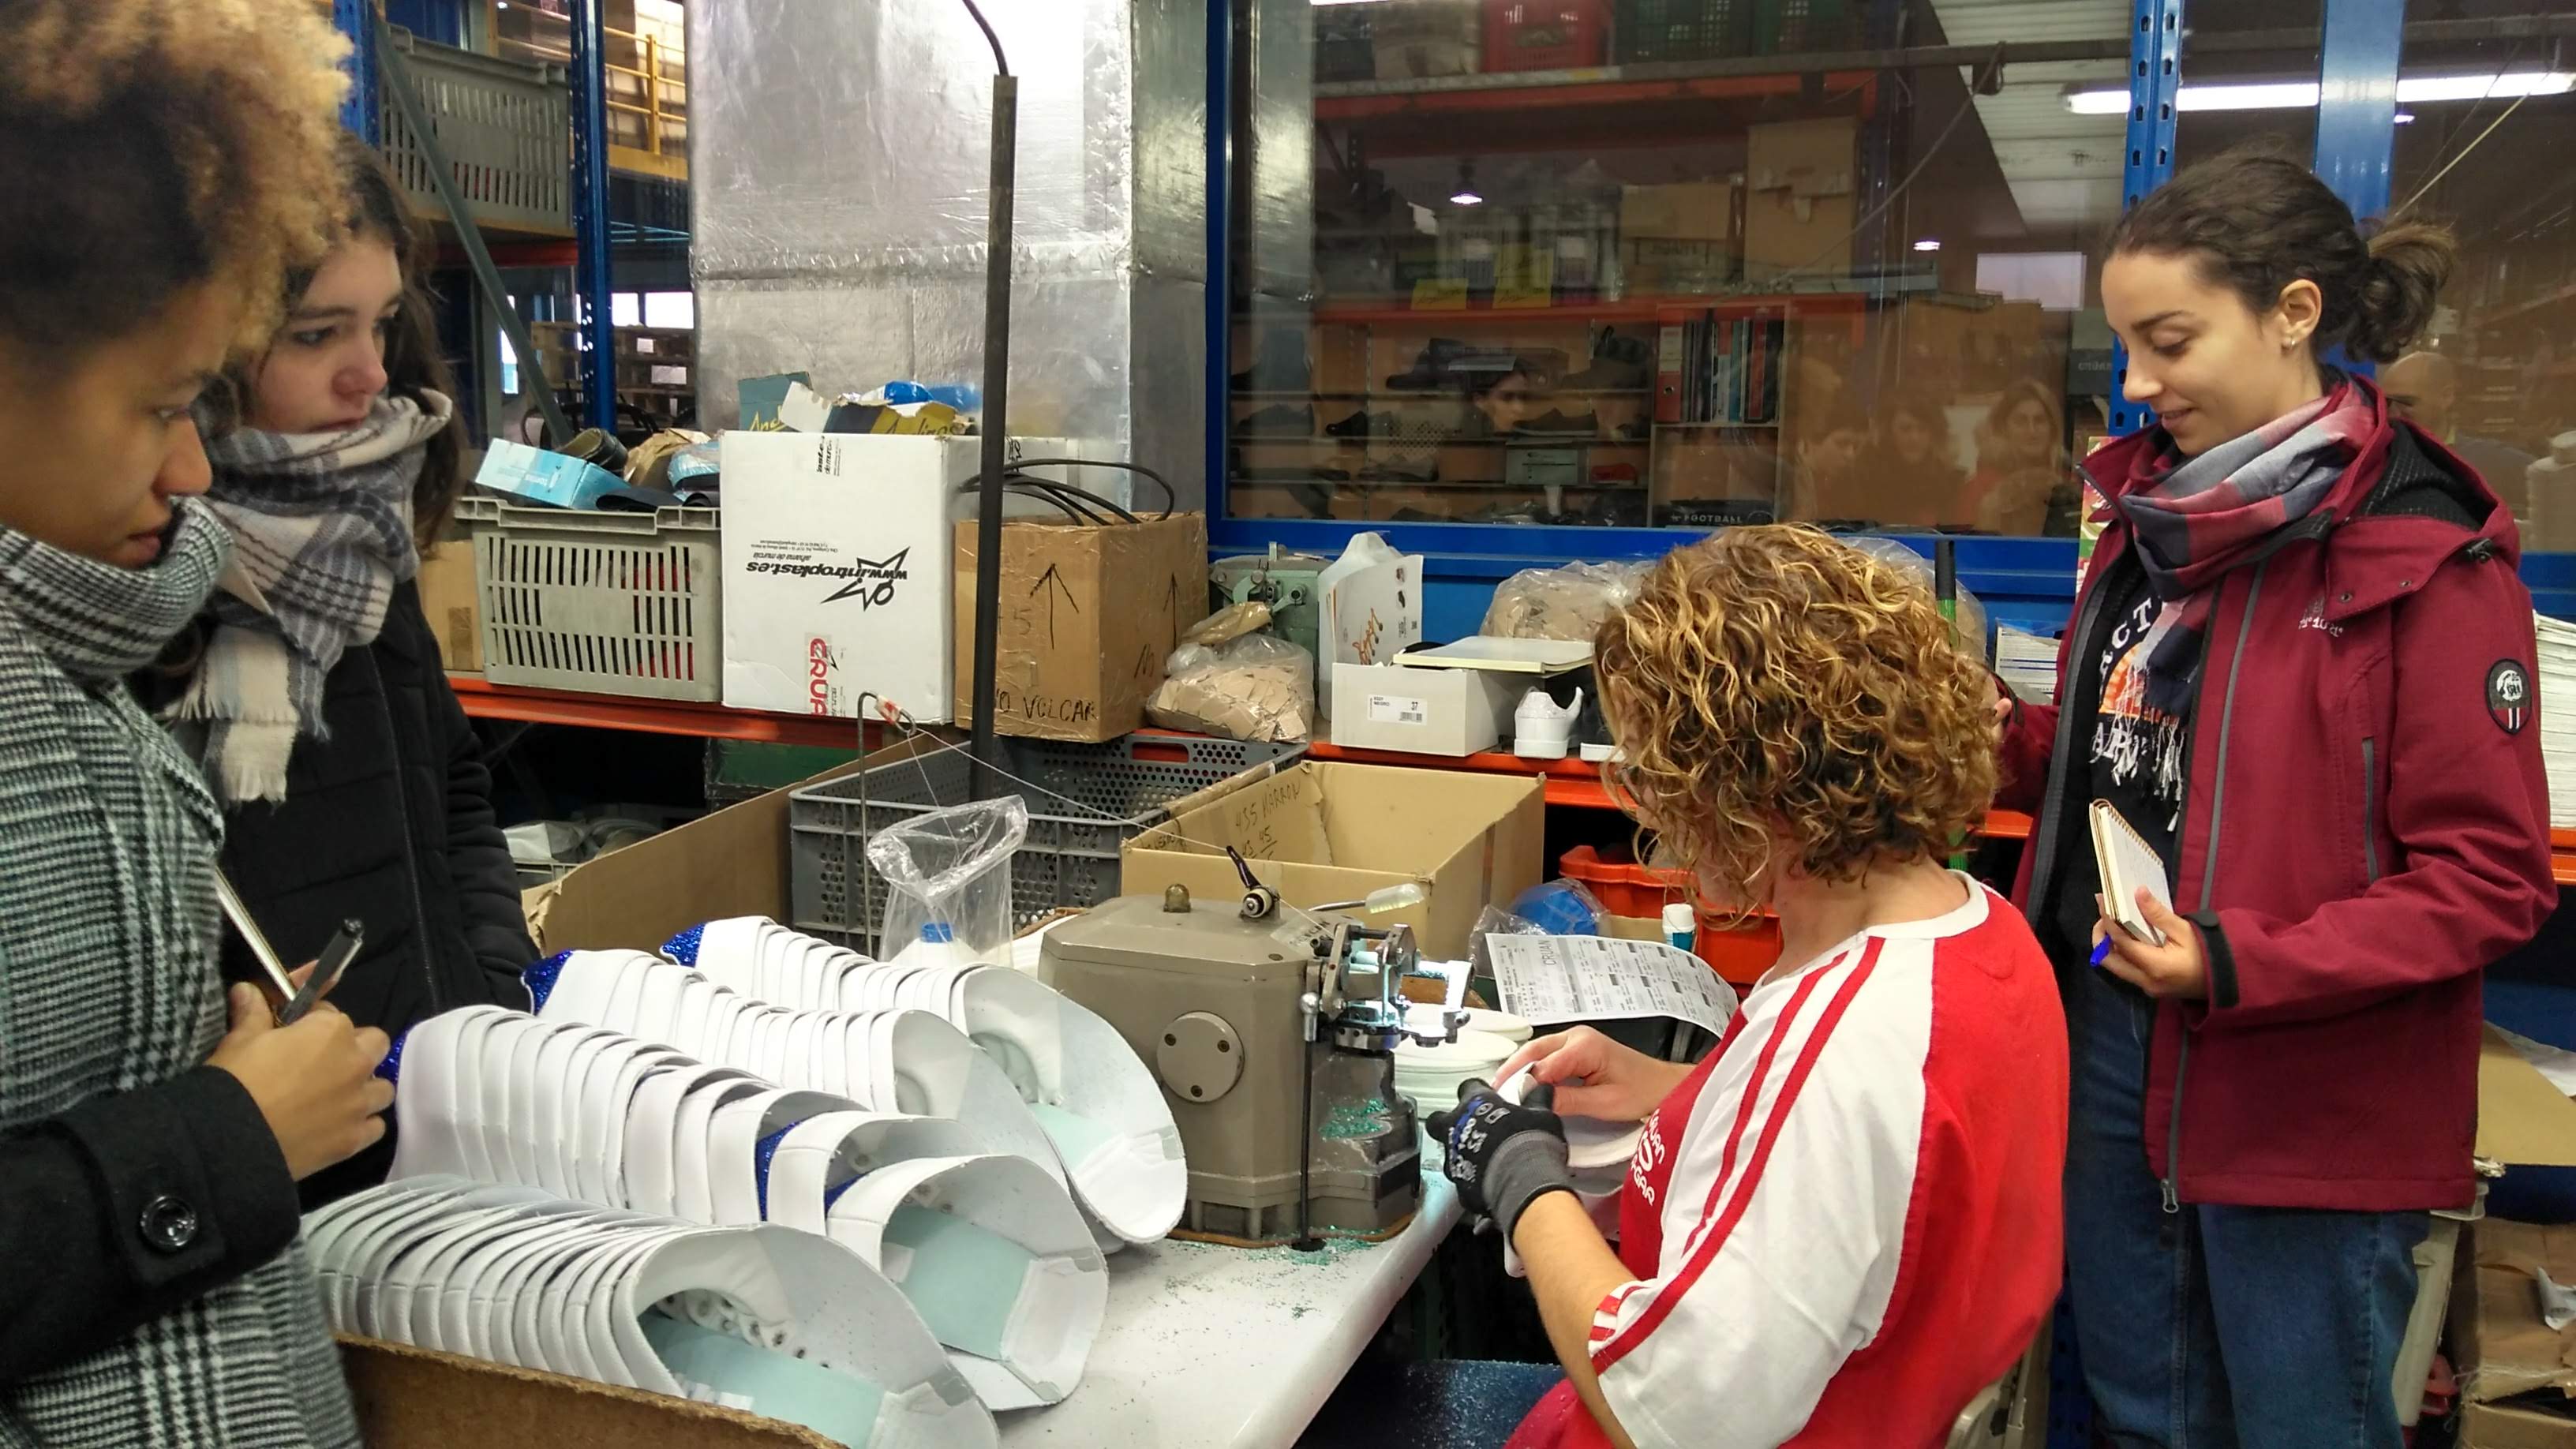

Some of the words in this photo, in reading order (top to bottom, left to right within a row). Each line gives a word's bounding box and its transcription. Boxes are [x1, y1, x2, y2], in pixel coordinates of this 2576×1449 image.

[753, 551, 777, 560] murcia
[777, 552, 786, 561] de
[746, 561, 908, 582] www.introplast.es
[810, 638, 828, 716] CRUA
[1537, 939, 1558, 967] CRUAN
